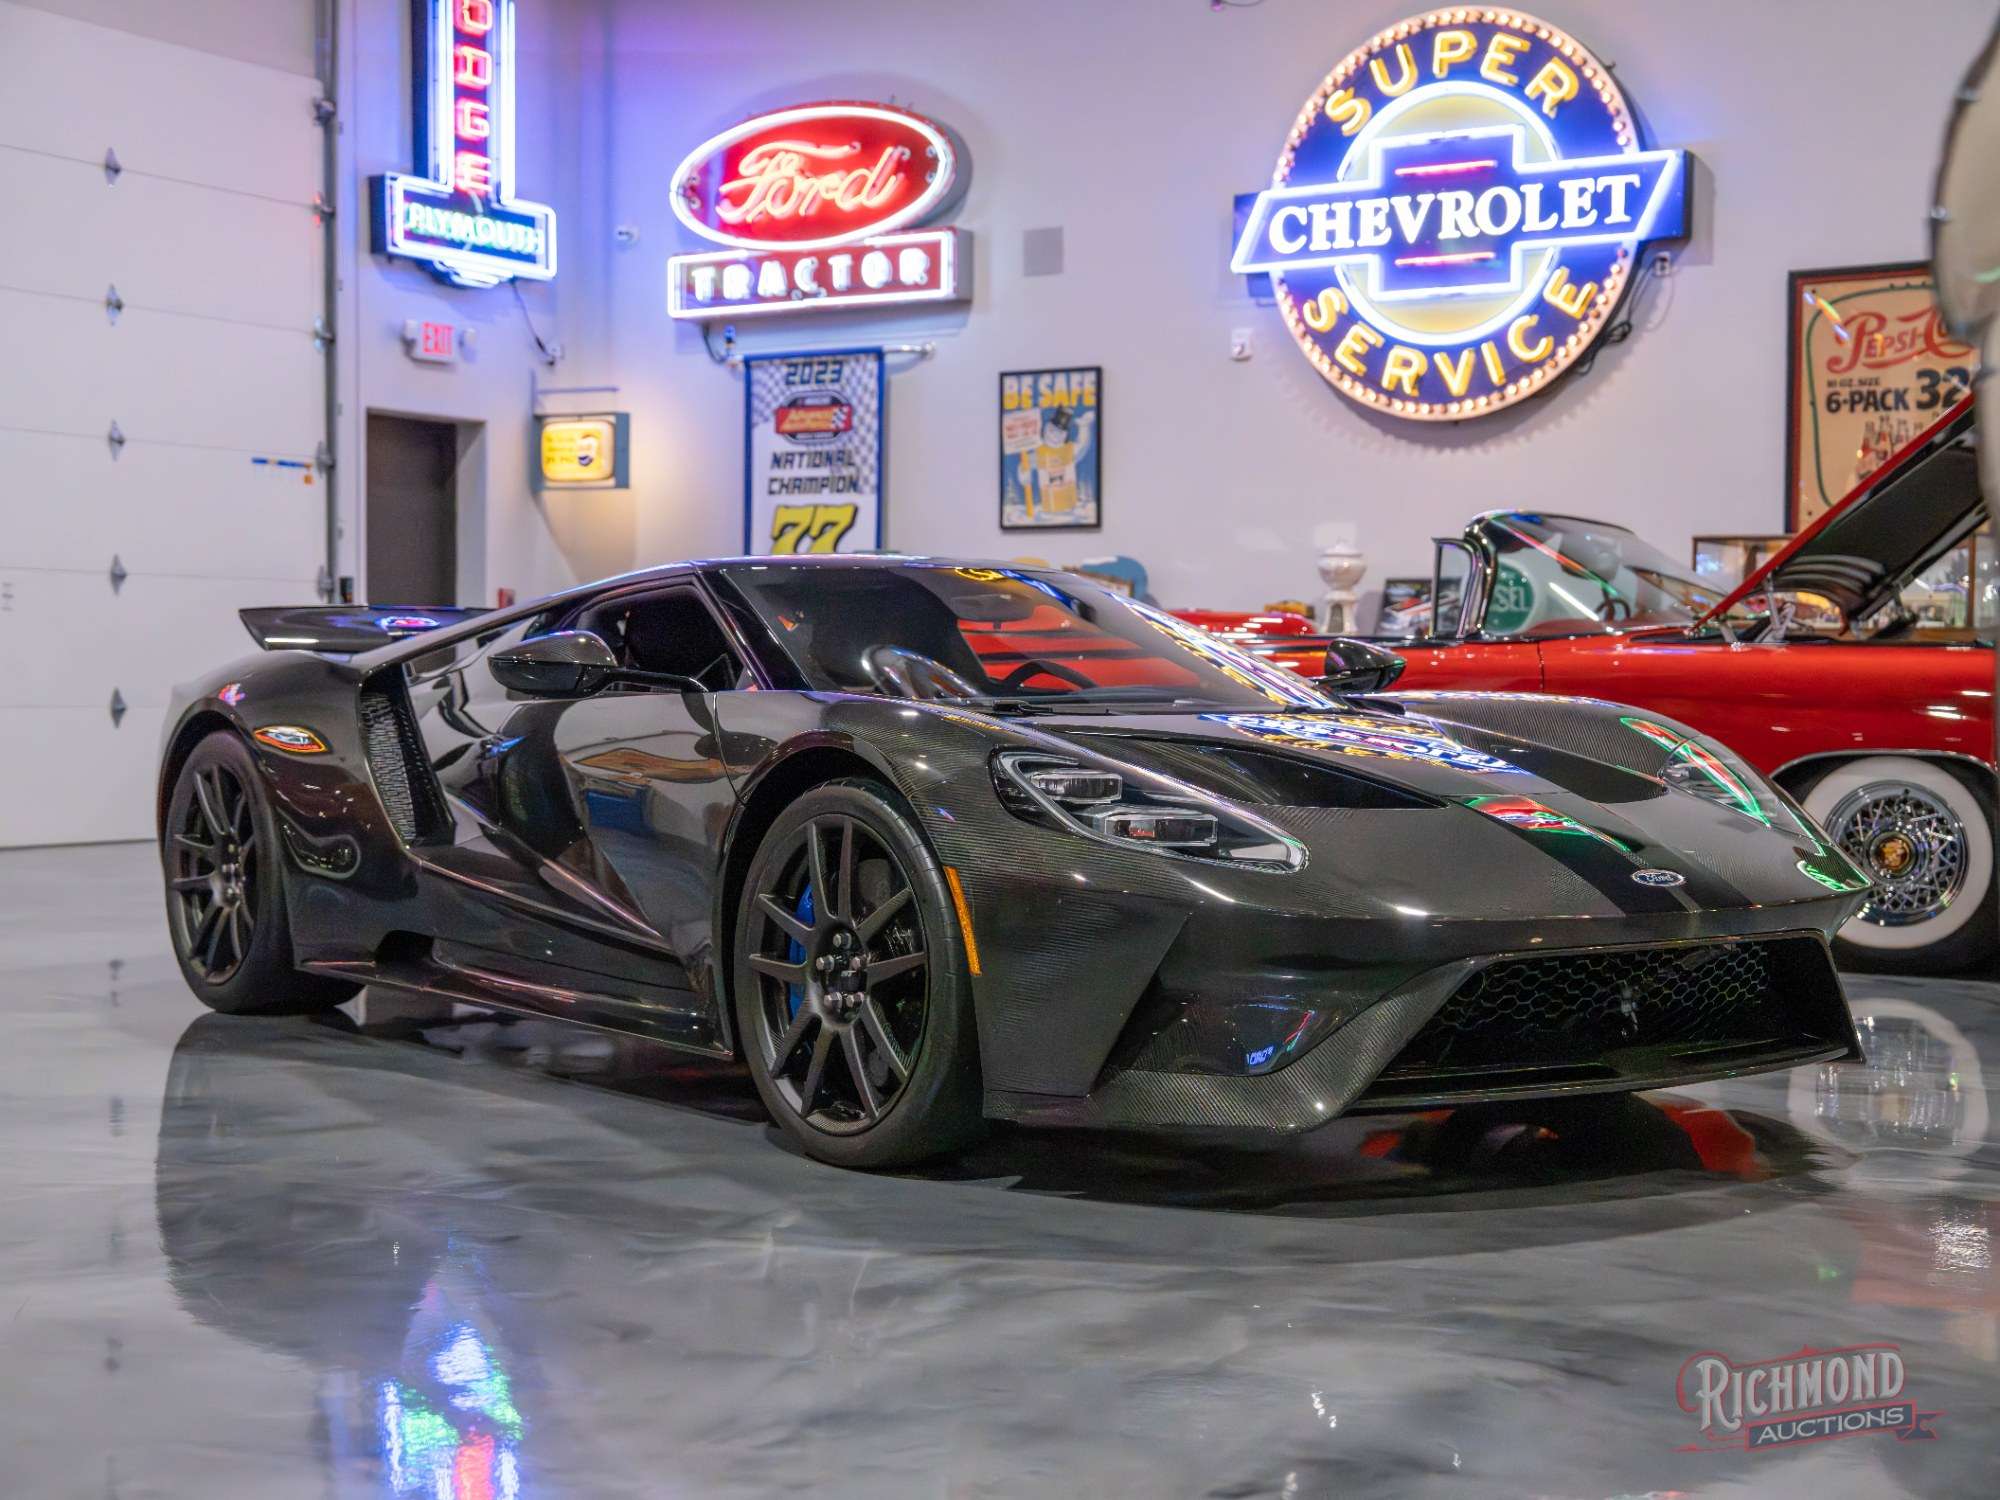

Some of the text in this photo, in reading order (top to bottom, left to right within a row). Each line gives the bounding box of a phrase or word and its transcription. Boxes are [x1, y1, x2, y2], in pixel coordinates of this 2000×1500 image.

[1324, 29, 1580, 137] SUPER
[715, 140, 909, 223] Ford
[406, 202, 545, 255] PLYMOUTH
[1268, 174, 1641, 254] CHEVROLET
[691, 247, 929, 302] TRACTOR
[422, 321, 455, 356] EXIT
[1302, 266, 1598, 398] SERVICE
[785, 359, 845, 386] 2023
[1003, 371, 1097, 410] BE SAFE
[1825, 388, 1910, 414] 6-PACK
[768, 475, 860, 496] CHAMPION
[770, 450, 858, 470] NATIONAL
[770, 503, 859, 555] 77
